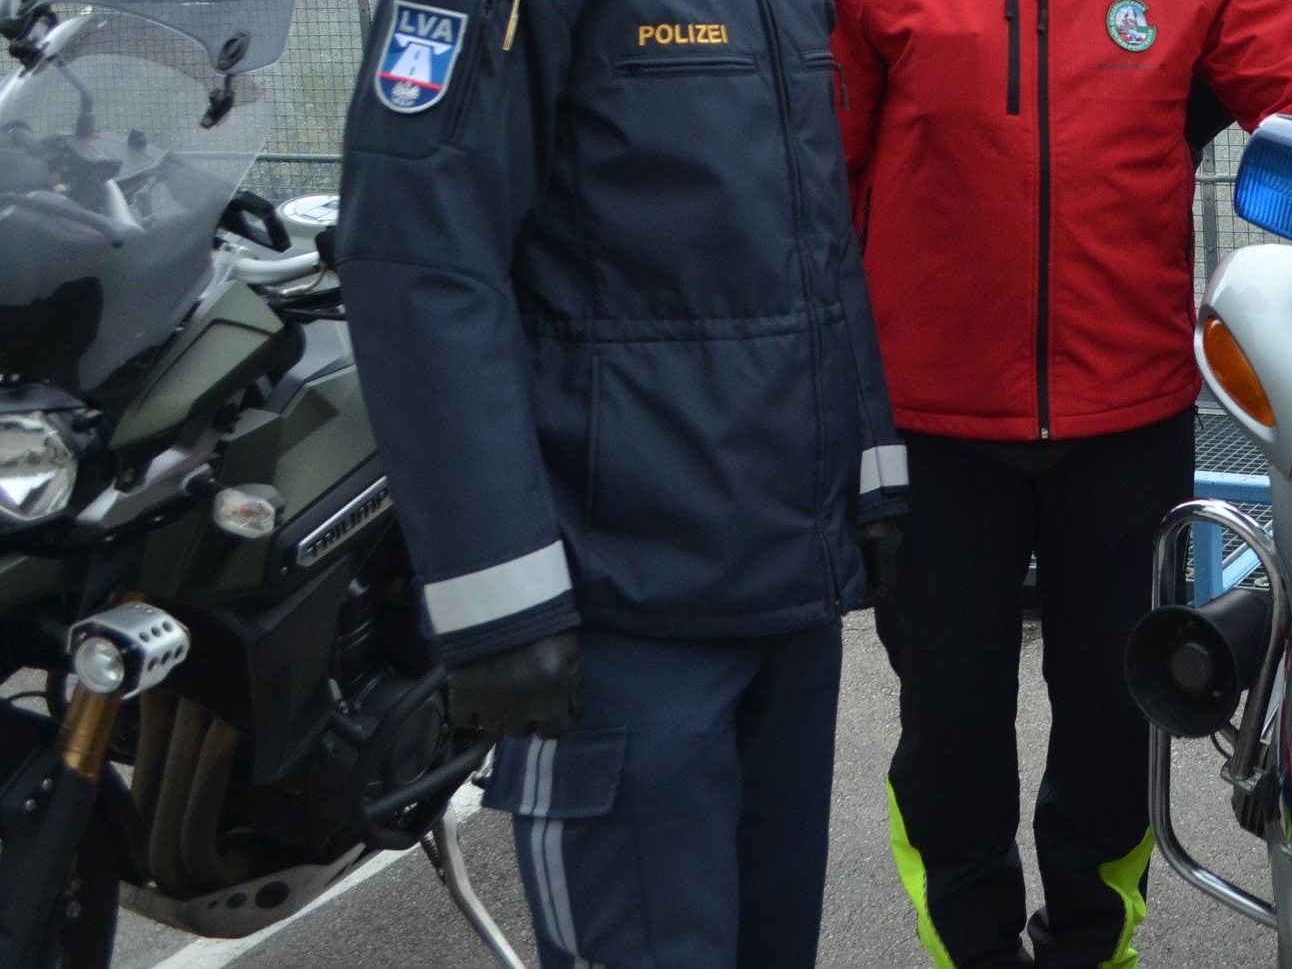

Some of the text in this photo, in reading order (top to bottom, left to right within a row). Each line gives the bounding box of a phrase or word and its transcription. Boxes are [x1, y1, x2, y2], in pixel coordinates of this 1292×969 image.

[399, 10, 454, 43] LVA
[638, 23, 729, 47] POLIZEI
[304, 486, 389, 559] TRIUMP
